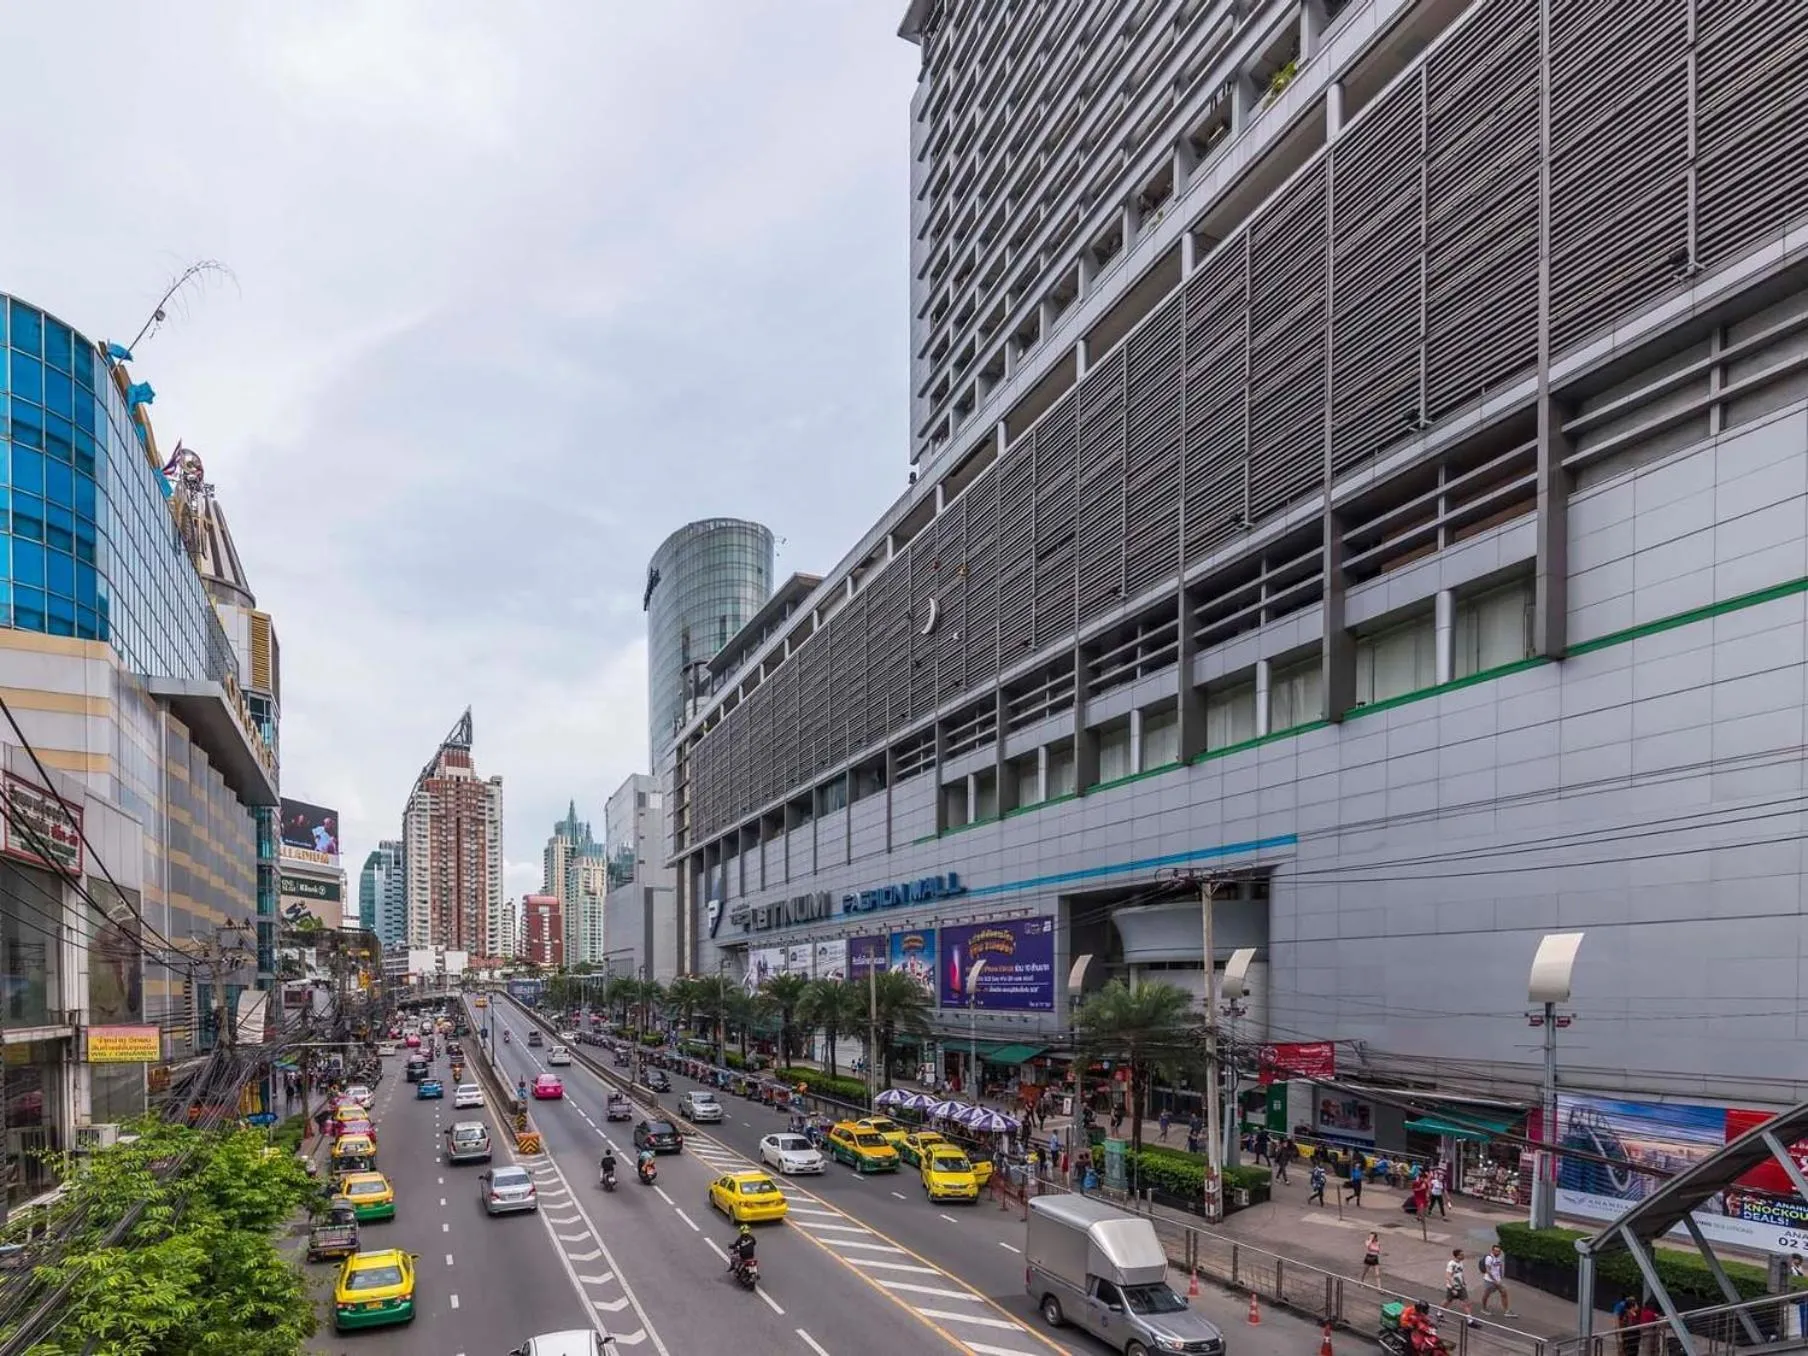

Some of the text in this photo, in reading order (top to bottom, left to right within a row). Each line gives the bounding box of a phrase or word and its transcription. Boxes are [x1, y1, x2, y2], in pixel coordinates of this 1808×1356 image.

[842, 882, 907, 914] FASHION
[909, 871, 968, 903] MALL
[1743, 1211, 1789, 1226] DEALS!
[1778, 1237, 1798, 1249] 02
